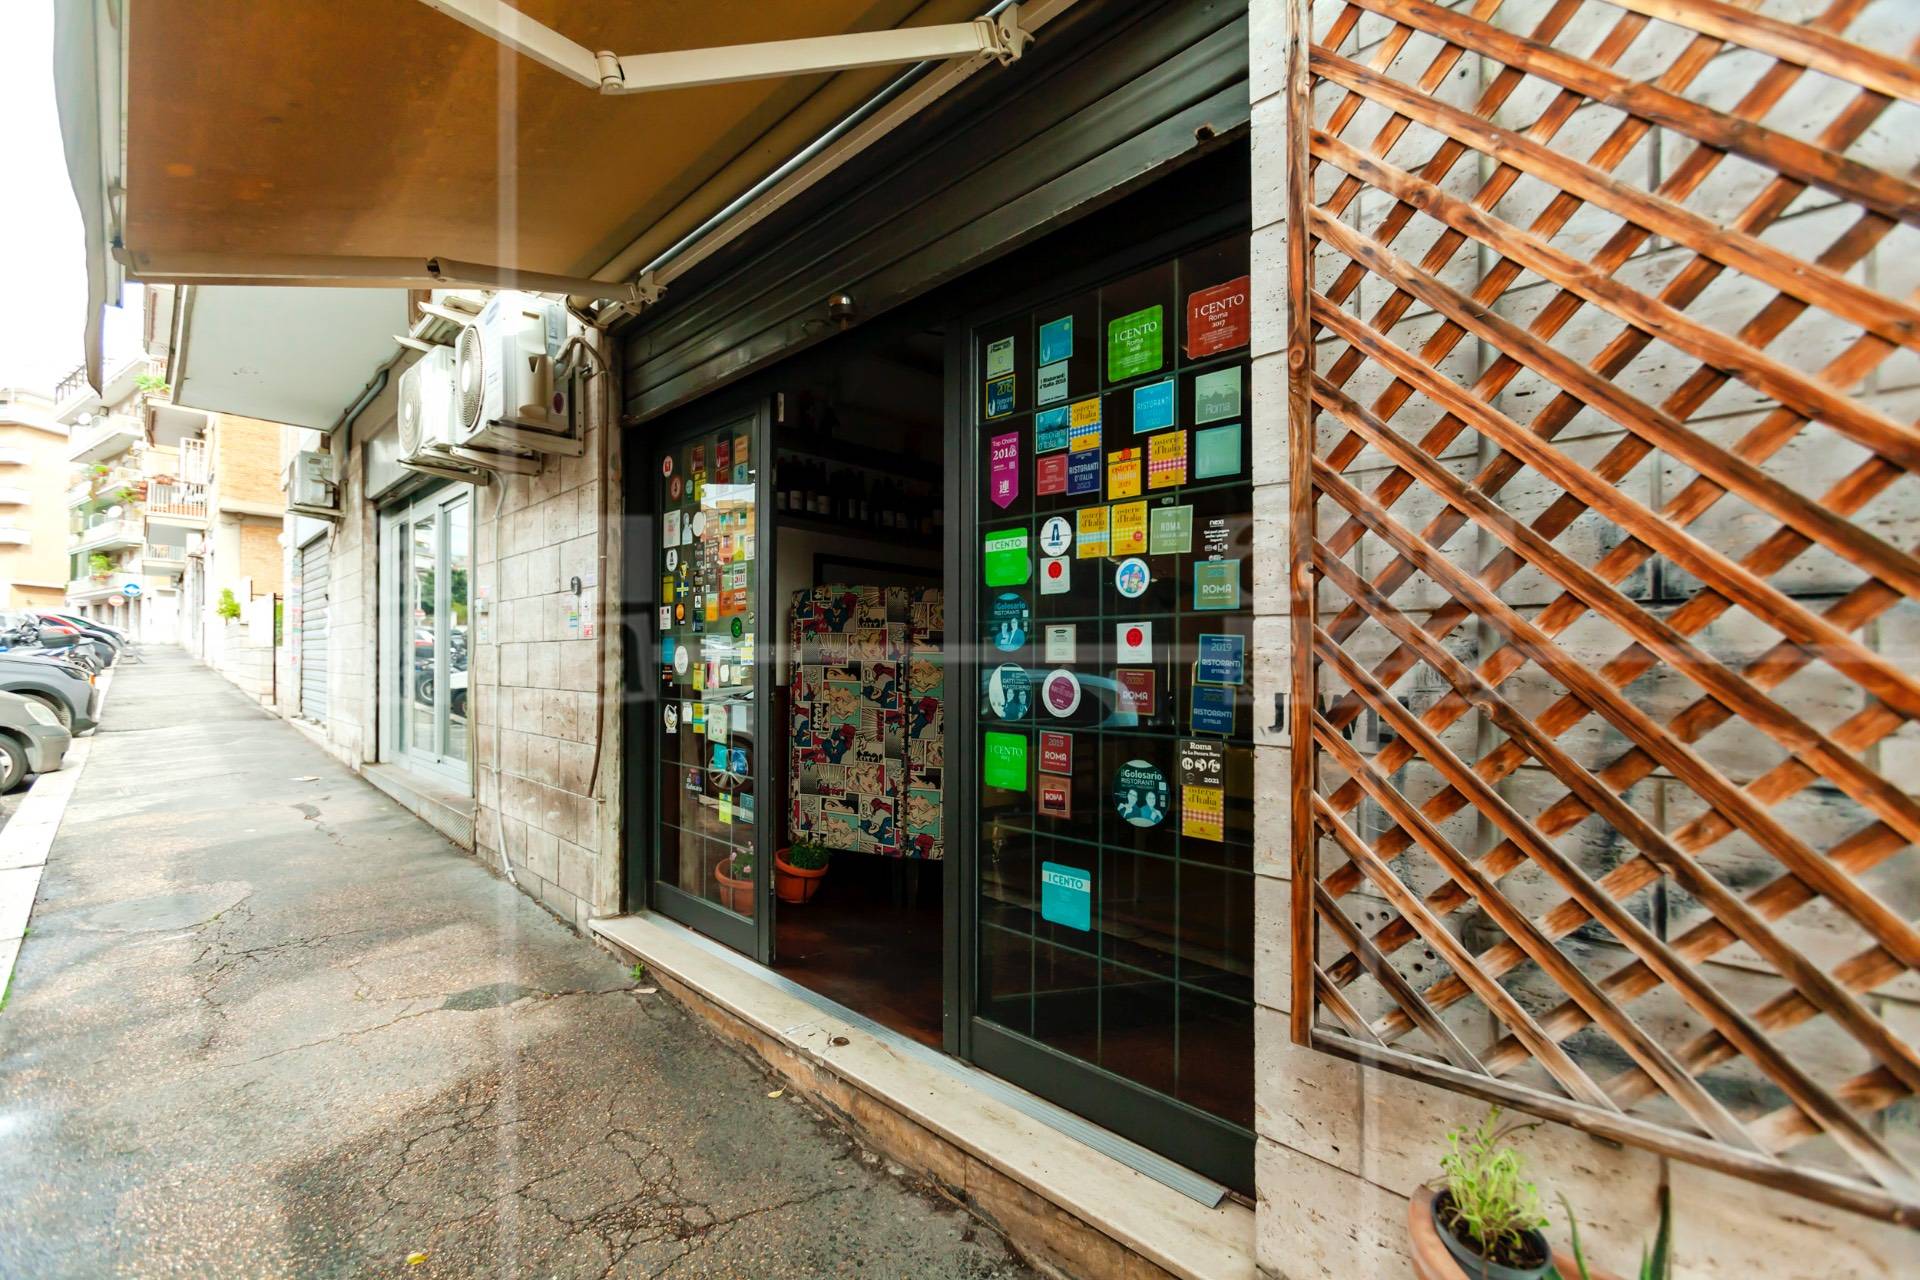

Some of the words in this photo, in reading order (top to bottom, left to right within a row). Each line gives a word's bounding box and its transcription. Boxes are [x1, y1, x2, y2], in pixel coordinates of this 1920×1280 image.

[1194, 307, 1199, 319] I
[1200, 293, 1245, 316] CENTO
[1208, 311, 1229, 322] Roma
[1211, 319, 1226, 328] 2017
[1119, 321, 1158, 341] CENTO
[1205, 402, 1231, 417] Roma
[1068, 461, 1099, 475] RISTORANTI
[994, 538, 1022, 550] CENTO
[1202, 583, 1232, 594] ROMA
[1210, 642, 1233, 651] 2019
[1201, 658, 1241, 668] RISTORANTI
[1122, 690, 1148, 700] ROMA
[1193, 707, 1232, 719] RISTORANTI
[993, 745, 1024, 759] CENTO
[1189, 742, 1212, 751] Roma
[1044, 751, 1067, 761] ROMA
[1120, 777, 1155, 786] RISTORANTI
[1045, 792, 1063, 801] ROMA
[1052, 873, 1083, 889] CENTO
